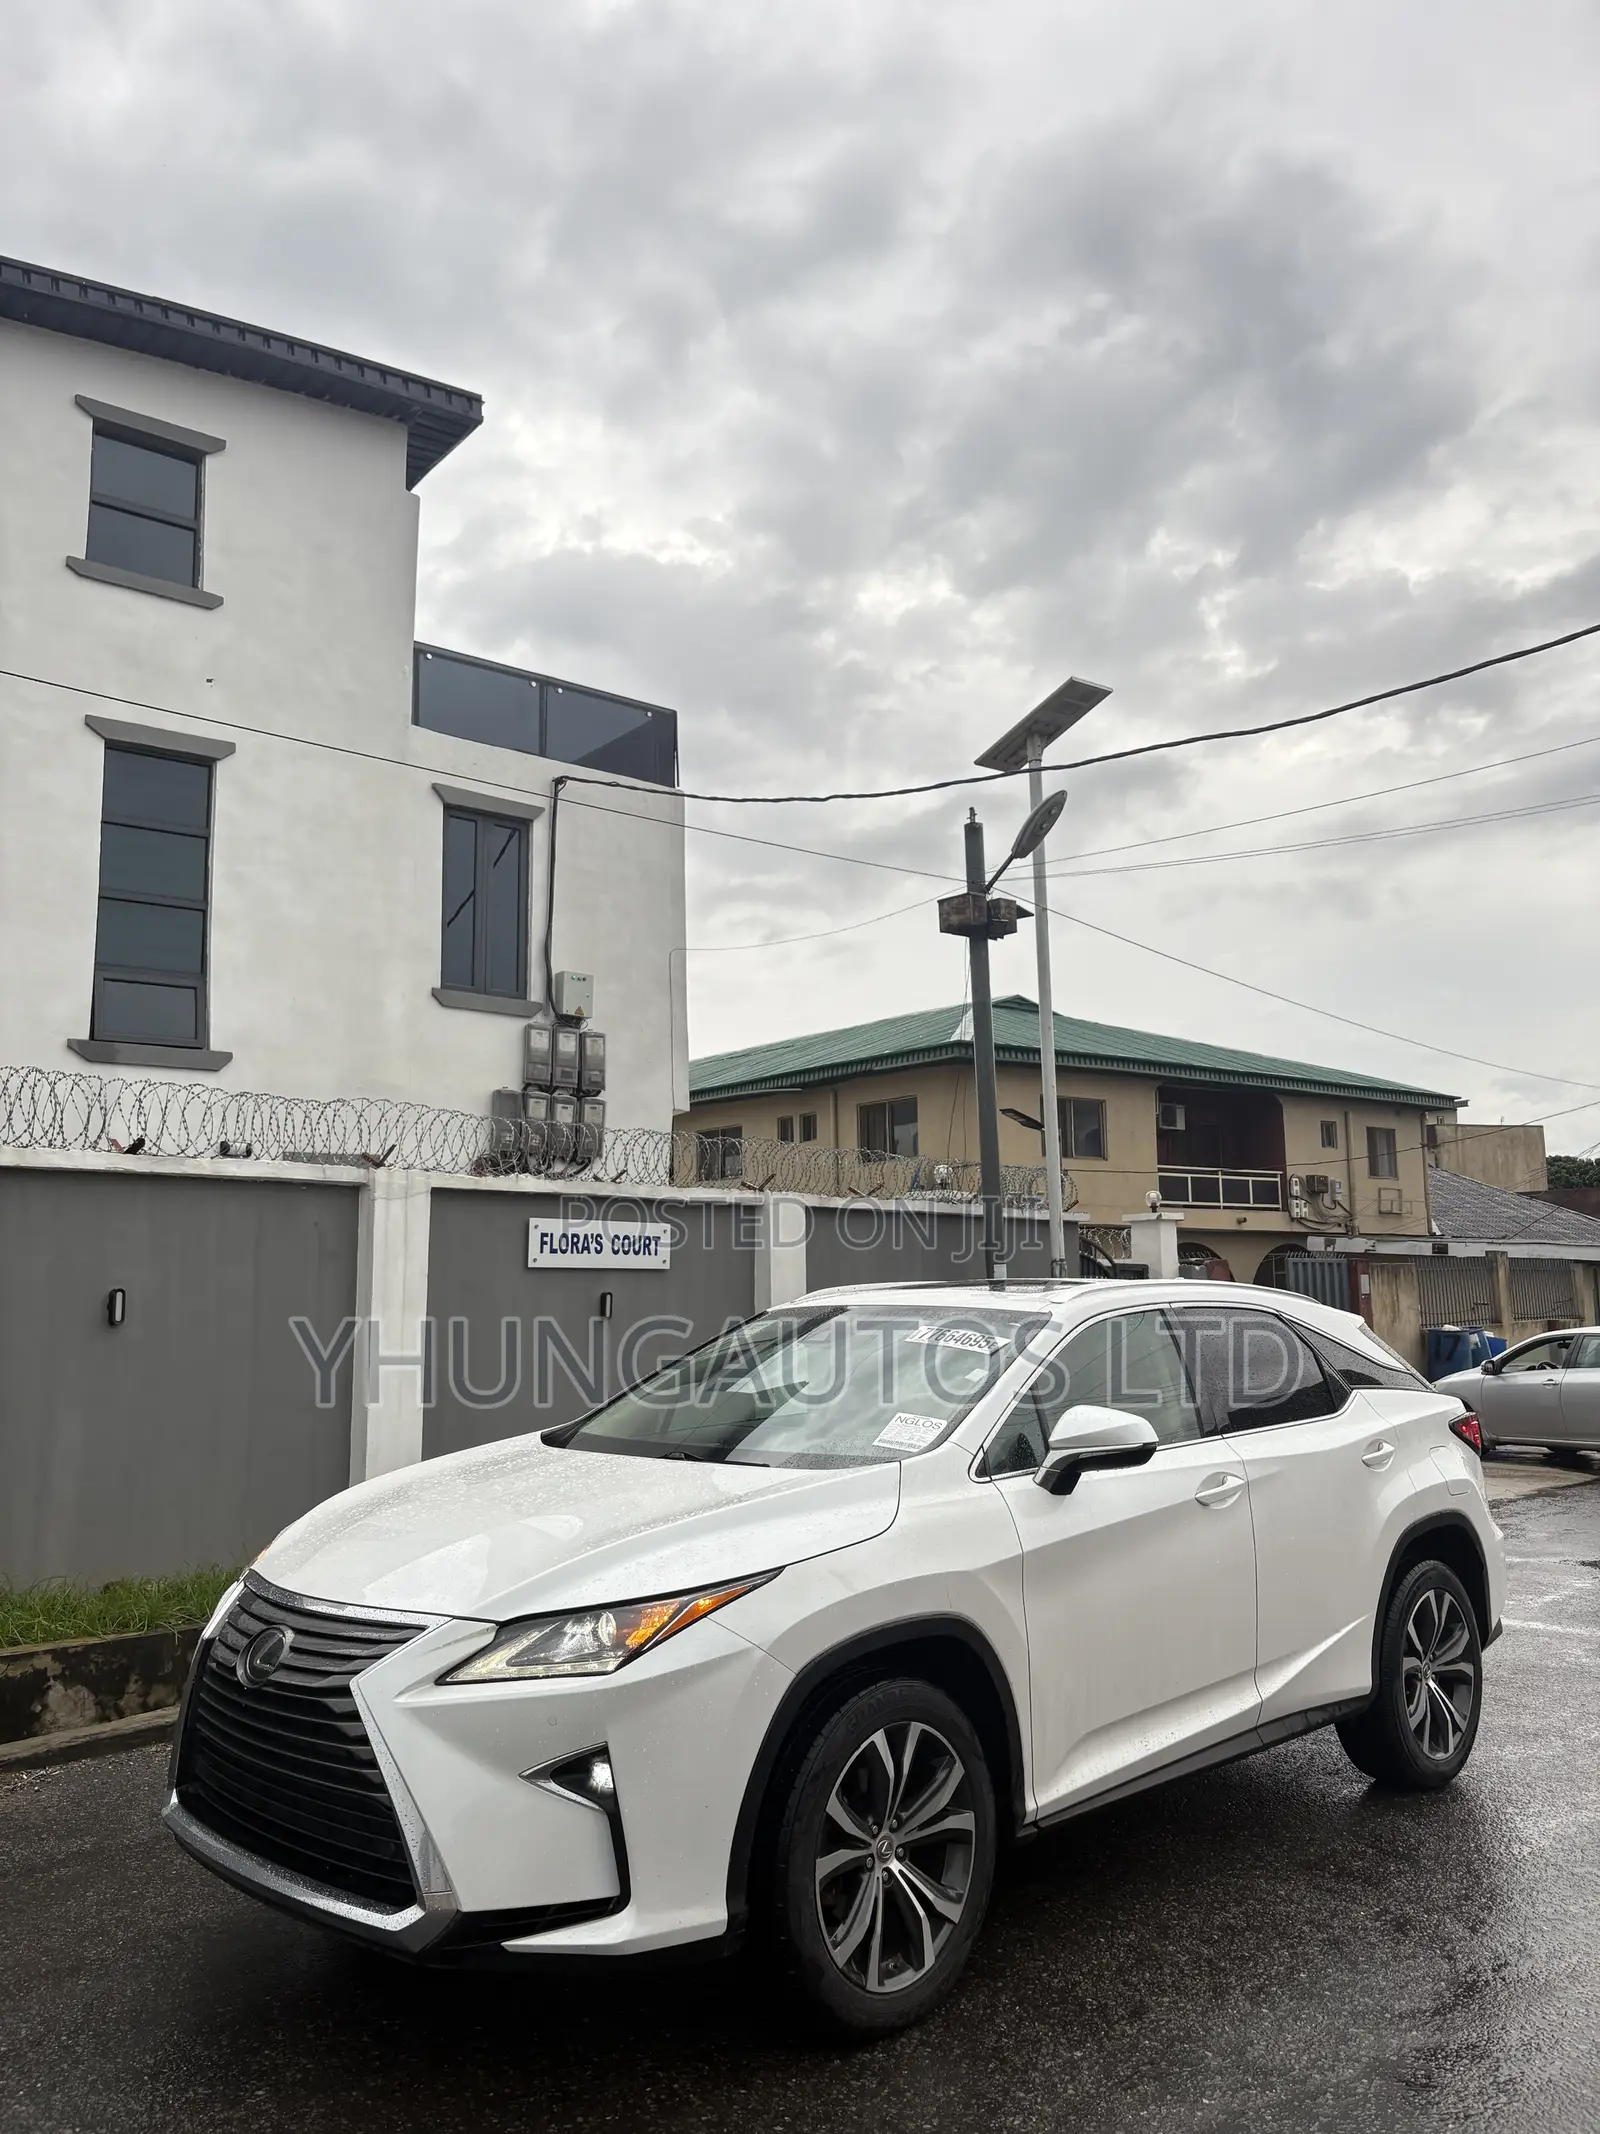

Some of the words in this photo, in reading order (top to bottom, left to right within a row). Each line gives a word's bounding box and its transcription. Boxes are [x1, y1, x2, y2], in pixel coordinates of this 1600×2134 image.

[539, 1232, 604, 1255] FLORA'S
[610, 1234, 661, 1256] COURT
[894, 1415, 943, 1430] NGLOS
